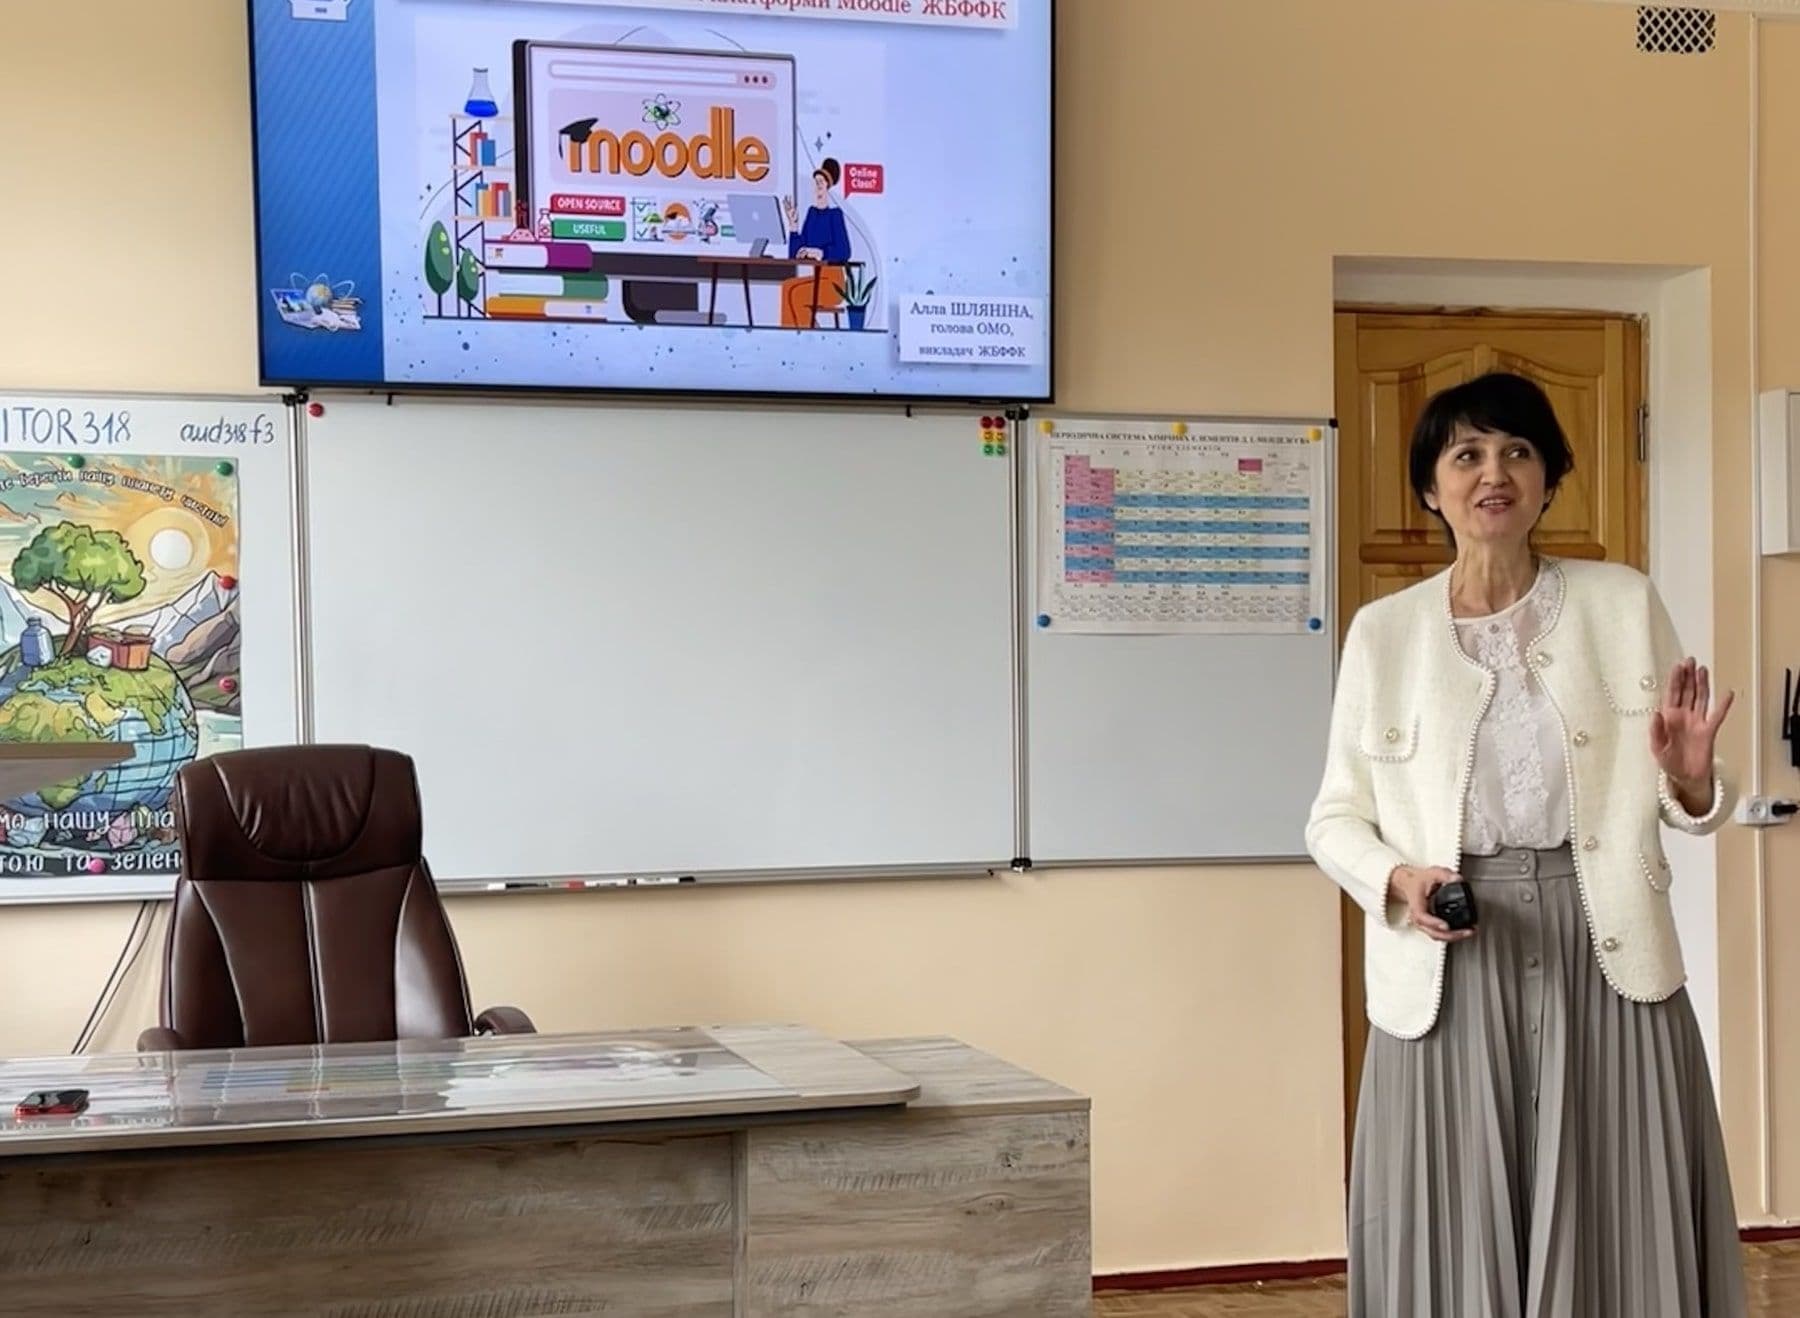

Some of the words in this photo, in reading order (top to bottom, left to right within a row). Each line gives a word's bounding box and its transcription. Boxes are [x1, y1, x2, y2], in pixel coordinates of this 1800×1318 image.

[922, 0, 1005, 19] ЖБФФК
[568, 106, 771, 182] moodle
[849, 167, 878, 178] Online
[557, 196, 583, 209] OPEN
[585, 197, 621, 211] SOURCE
[573, 223, 607, 235] USEFUL
[910, 302, 946, 315] Алла
[950, 302, 1034, 319] ШЛЯНІНА,
[931, 323, 974, 335] голова
[976, 321, 1014, 336] ОМО,
[919, 346, 973, 357] викладач
[978, 345, 1026, 357] ЖБФФК
[44, 810, 110, 834] нашу
